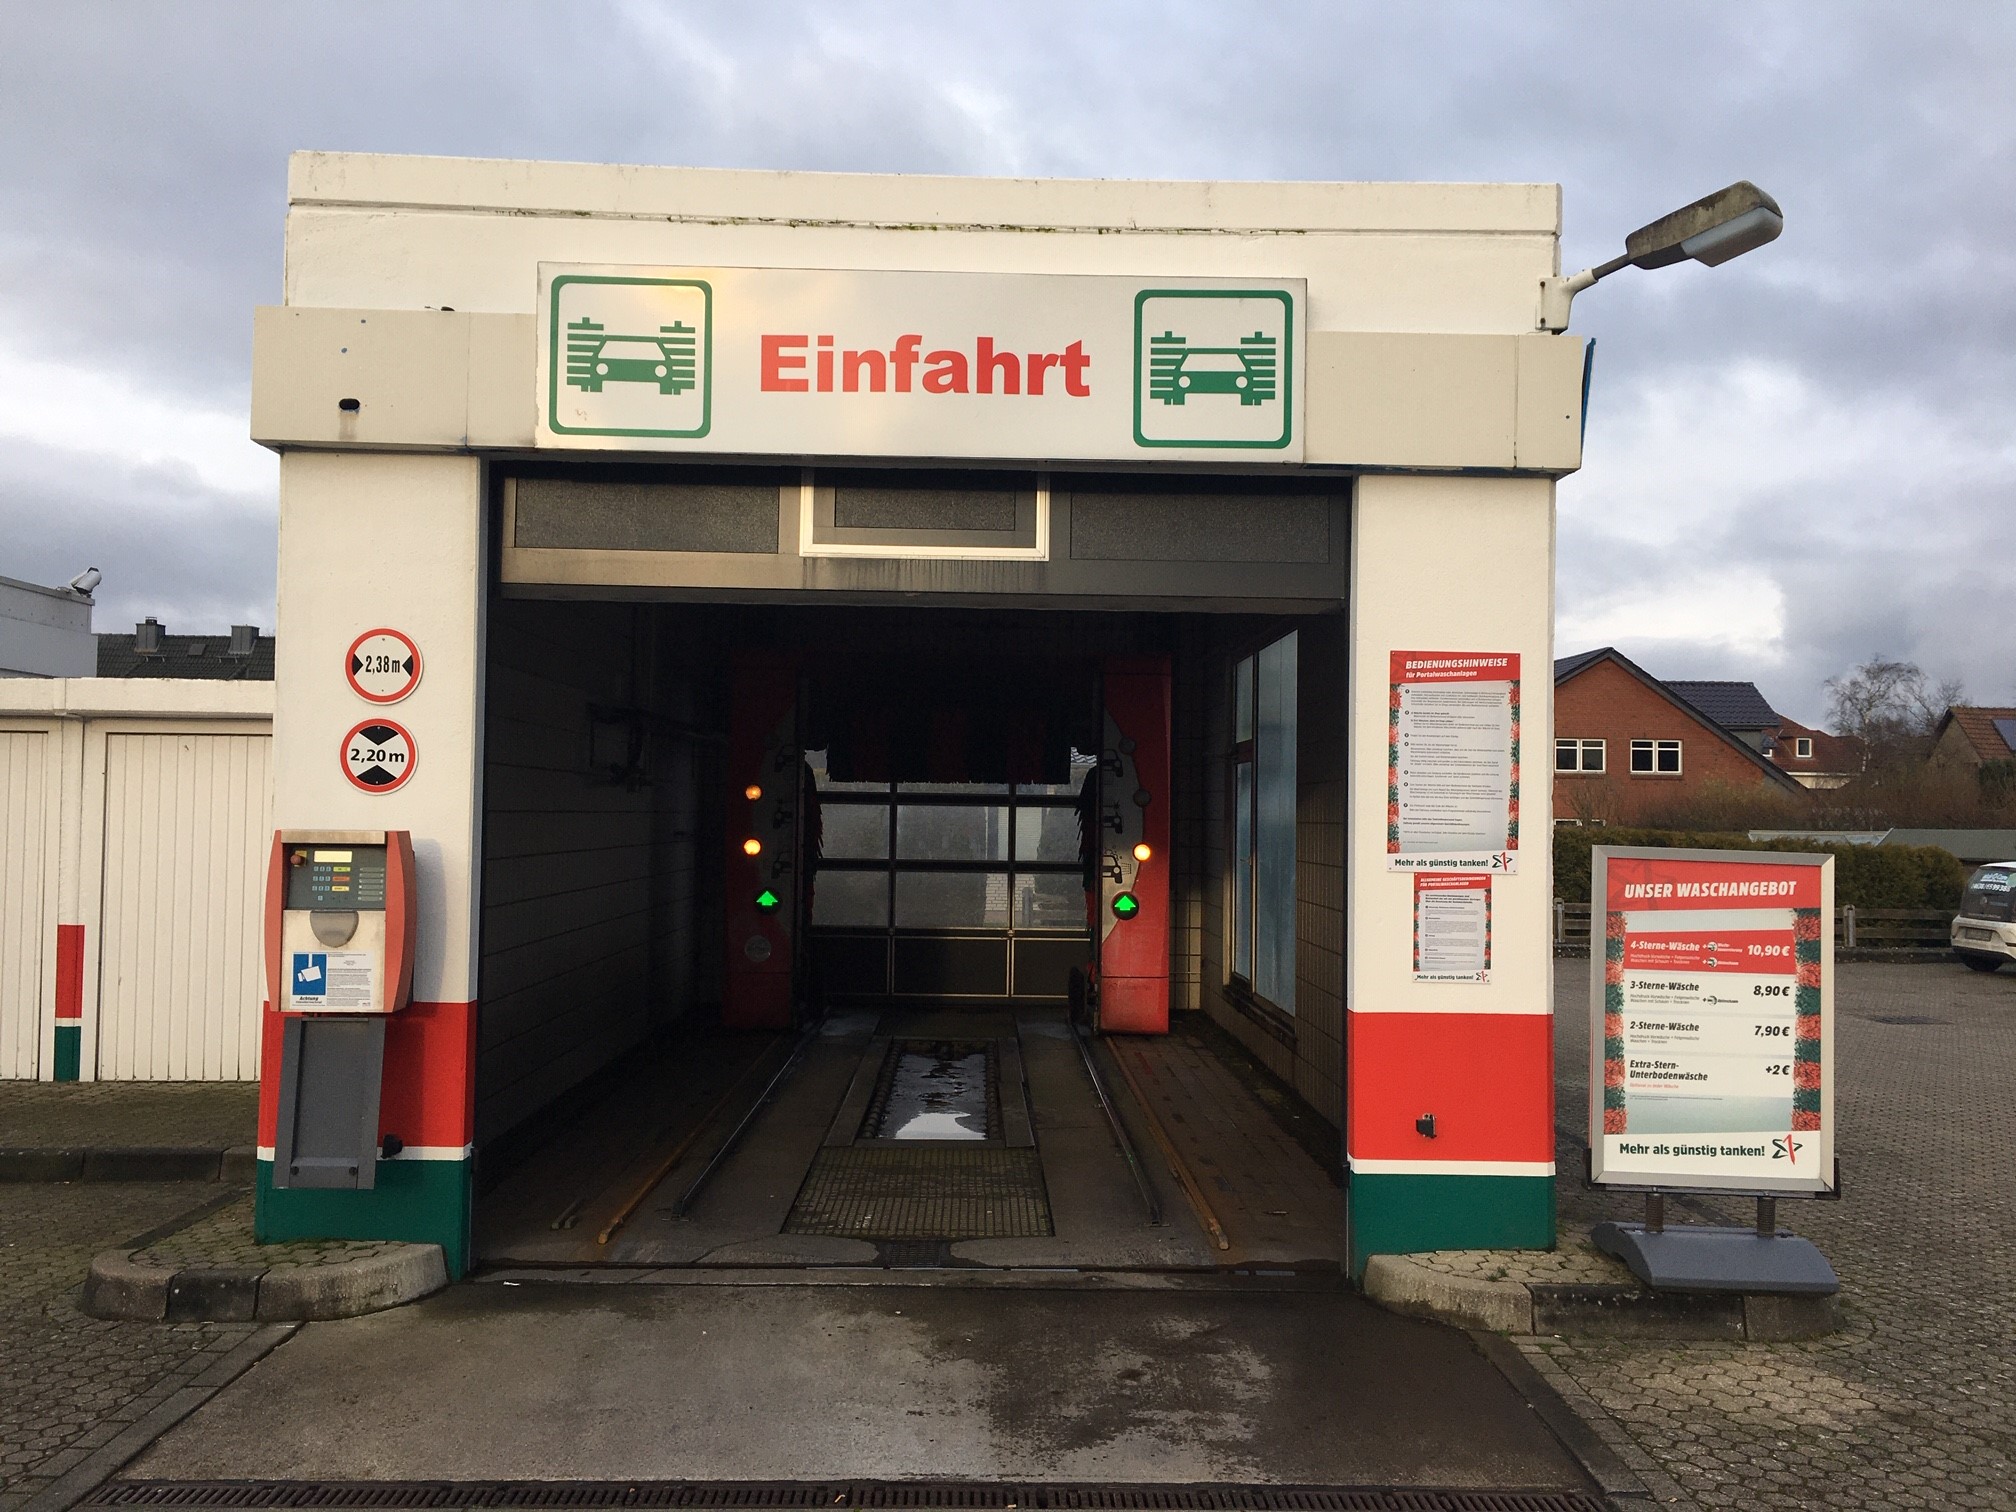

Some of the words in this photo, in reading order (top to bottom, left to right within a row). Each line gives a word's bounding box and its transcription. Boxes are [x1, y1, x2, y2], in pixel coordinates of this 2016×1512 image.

[760, 334, 1091, 398] Einfahrt
[365, 655, 390, 675] 2,38
[391, 659, 401, 673] m
[1405, 657, 1508, 669] BEDIENUNGSHINWEISE
[1405, 671, 1415, 679] für
[1416, 670, 1478, 679] Portalwaschanlagen
[350, 748, 386, 764] 2,20
[388, 751, 405, 763] m
[1394, 859, 1414, 867] Mehr
[1416, 859, 1427, 867] als
[1429, 858, 1458, 869] günstig
[1459, 858, 1489, 867] tanken!
[1624, 883, 1672, 899] UNSER
[1676, 881, 1797, 898] WASCHANGEBOT
[1630, 940, 1700, 952] 4-Sterne-Wäsche
[1747, 944, 1780, 957] 10,90
[1782, 945, 1790, 957] €
[1630, 980, 1700, 991] 3-Sterne-Wäsche
[1753, 985, 1780, 997] 8,90
[1782, 986, 1790, 997] €
[1630, 1021, 1700, 1032] 2-Sterne-Wäsche
[1754, 1025, 1780, 1038] 7,90
[1782, 1026, 1790, 1037] €
[1630, 1059, 1679, 1070] Extra-Stern-
[1765, 1065, 1780, 1075] +2
[1782, 1065, 1790, 1075] €
[1630, 1070, 1708, 1081] Unterbodenwäsche
[1619, 1143, 1650, 1155] Mehr
[1652, 1143, 1670, 1155] als
[1673, 1144, 1717, 1157] günstig
[1719, 1144, 1765, 1157] tanken!
